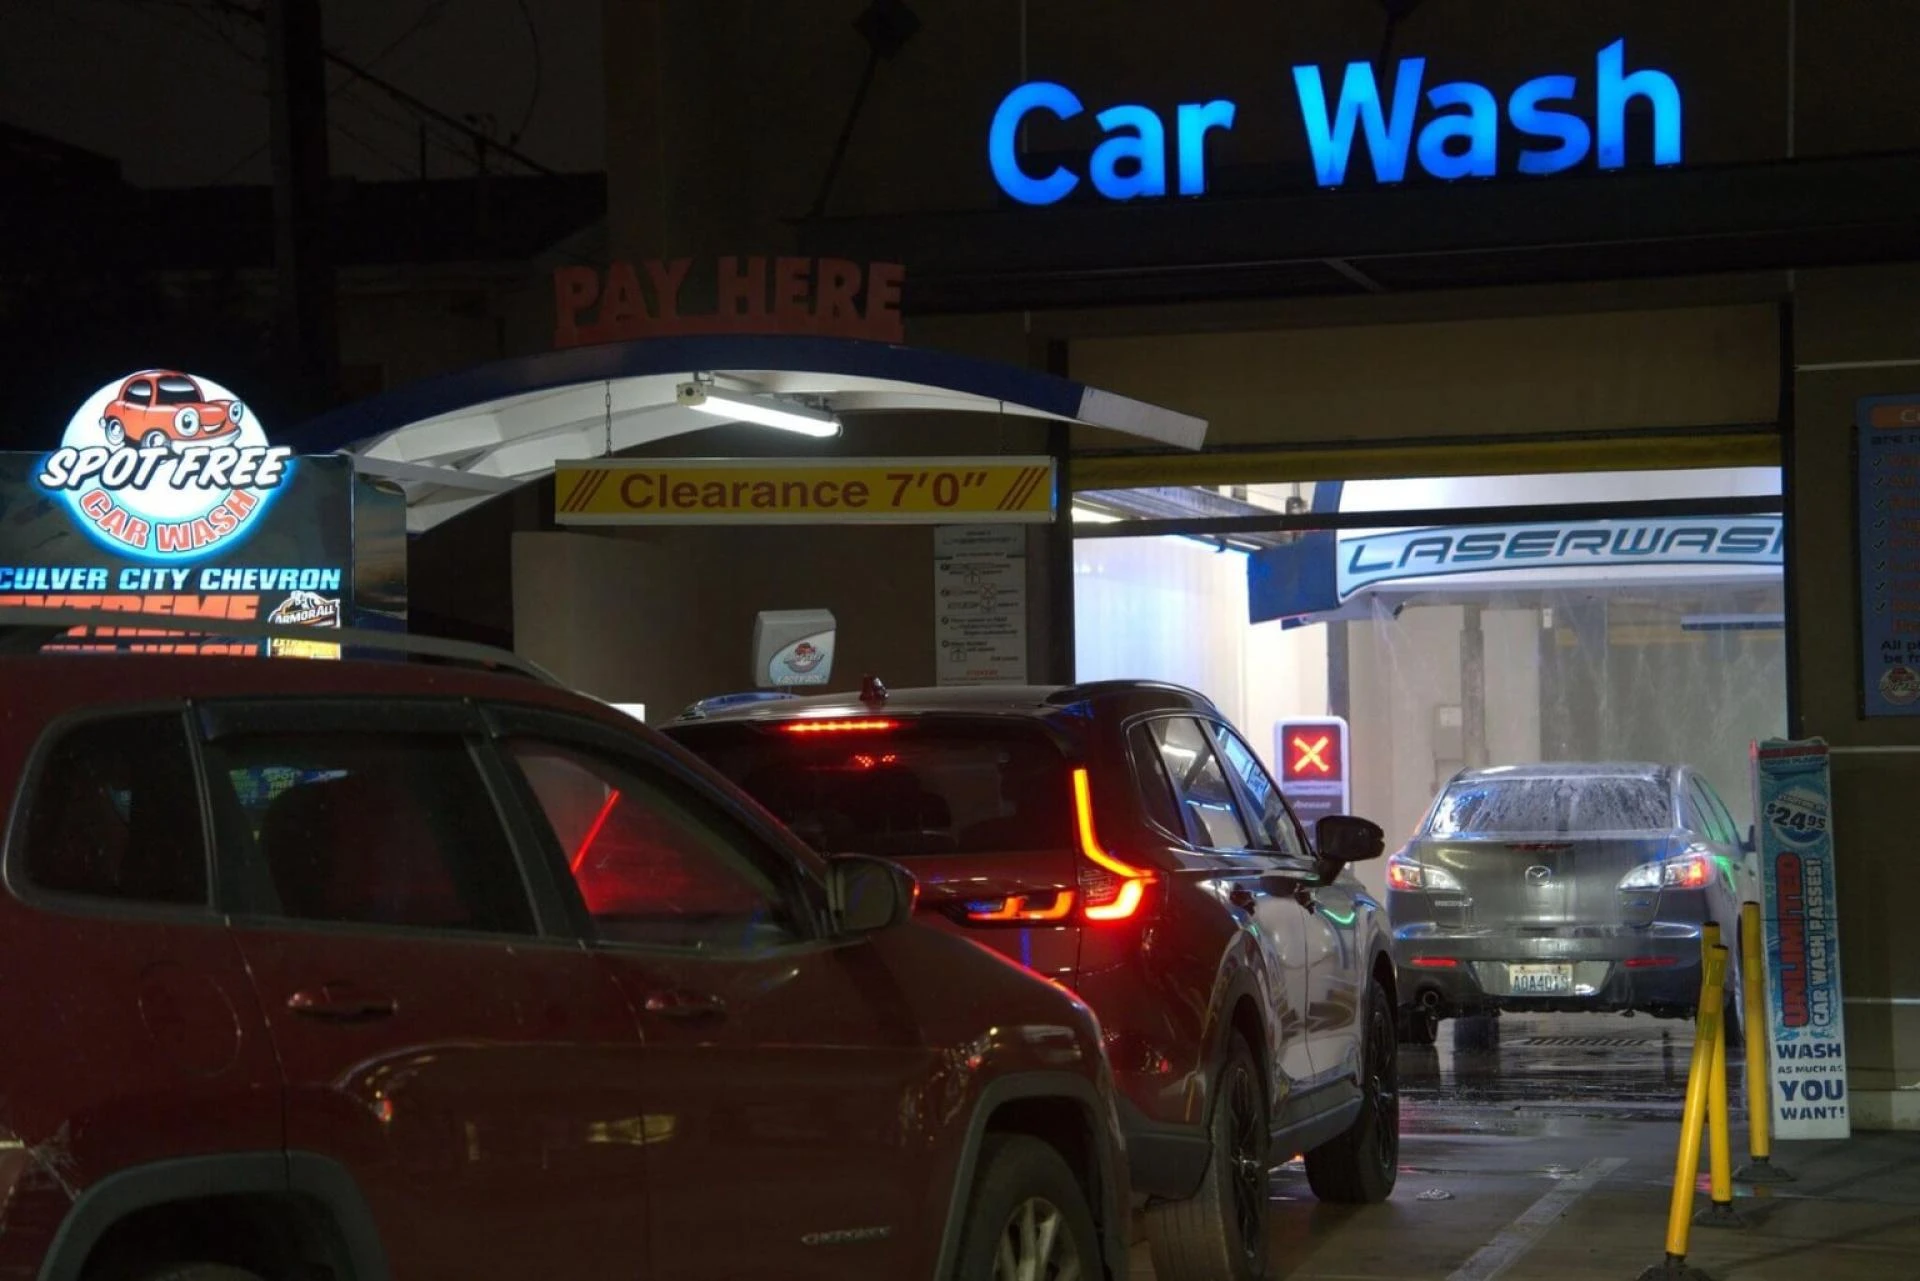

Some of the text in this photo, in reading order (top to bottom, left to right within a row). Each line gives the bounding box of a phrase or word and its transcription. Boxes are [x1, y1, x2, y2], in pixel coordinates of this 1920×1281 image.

[988, 37, 1682, 206] Car Wash
[553, 256, 906, 332] PAY HERE
[39, 446, 291, 489] SPOT FREE
[619, 472, 870, 510] Clearance
[80, 488, 259, 552] CAR WASH
[0, 567, 341, 591] CULVER CITY CHEVRON
[1776, 852, 1809, 1027] UNLIMITED
[1806, 858, 1829, 1026] CAR WASH PASSES!
[1776, 1043, 1842, 1059] WASH
[1778, 1066, 1792, 1074] AS
[1795, 1065, 1827, 1073] MUCH
[1778, 1079, 1844, 1102] YOU
[1780, 1106, 1845, 1121] WANT!
